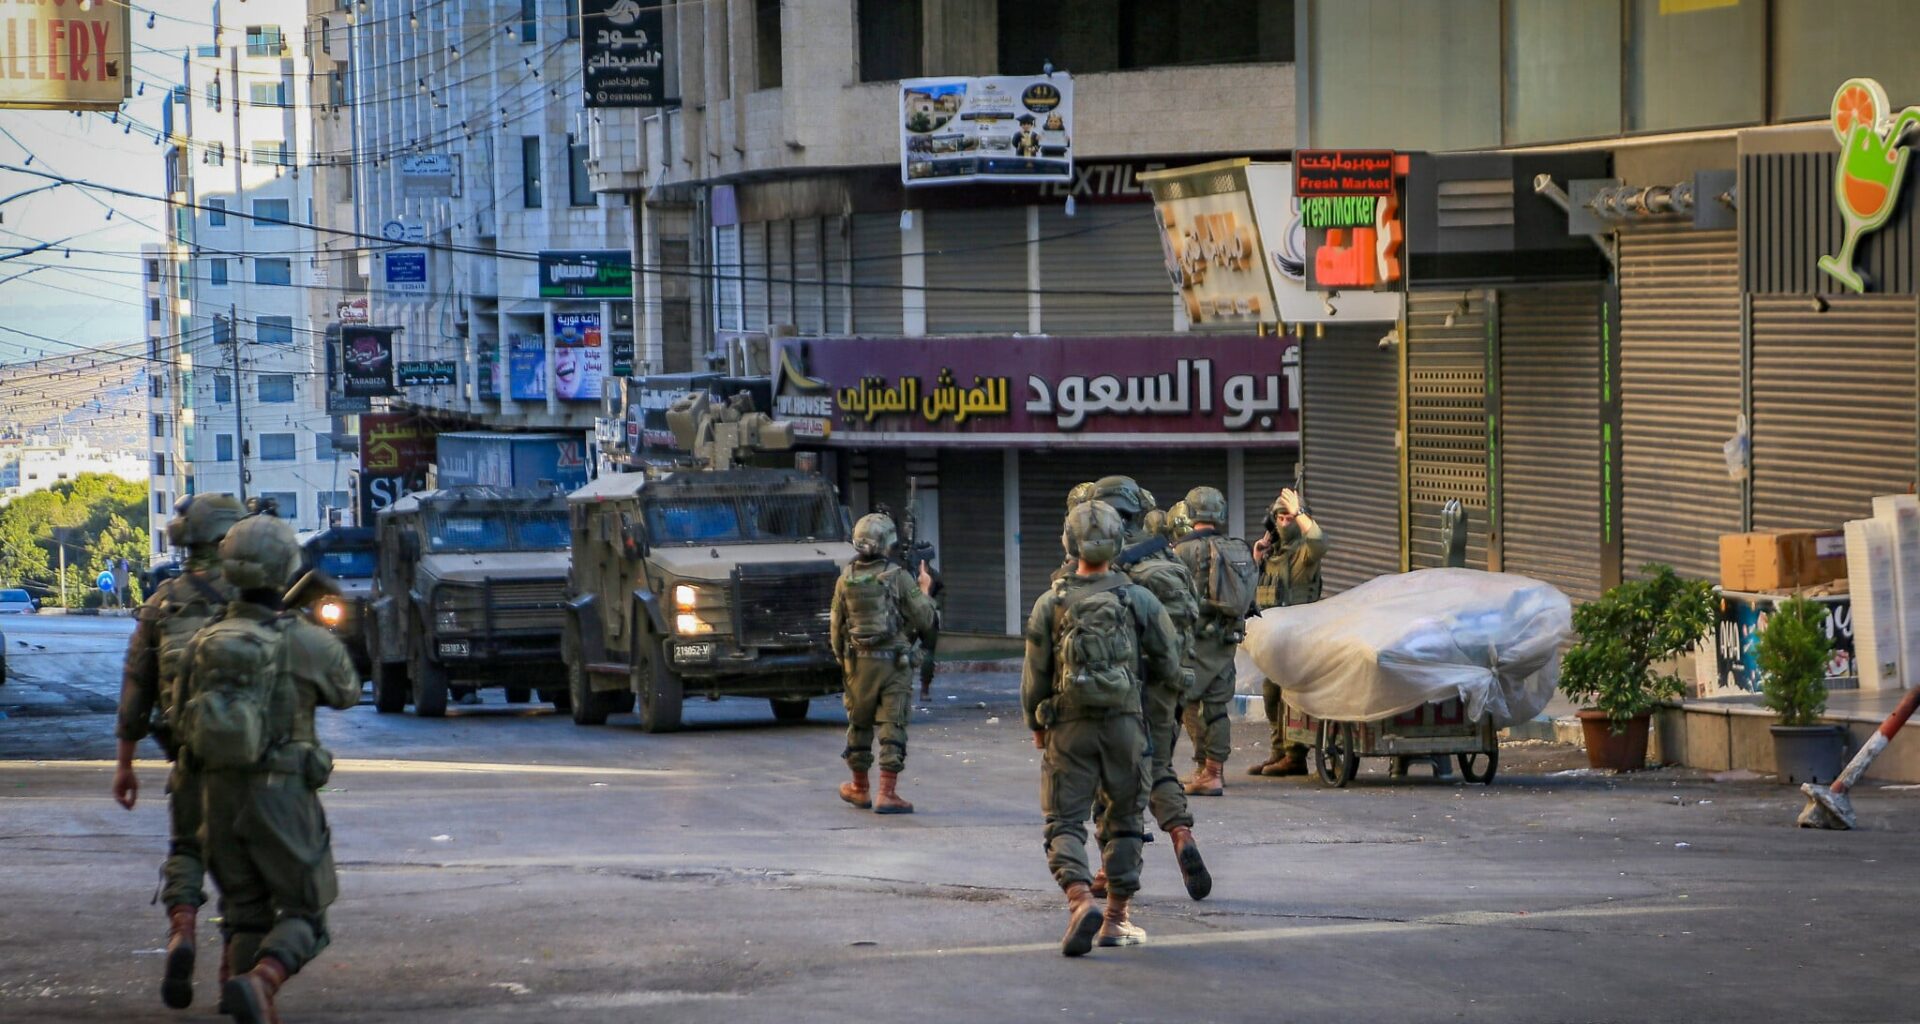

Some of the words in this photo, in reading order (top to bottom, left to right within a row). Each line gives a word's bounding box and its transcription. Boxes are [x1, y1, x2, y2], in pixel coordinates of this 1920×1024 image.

[0, 18, 110, 82] LLERY
[597, 29, 648, 49] جود
[588, 50, 661, 72] للسيدات
[1300, 151, 1390, 170] سوبرماركت
[1300, 177, 1338, 190] Fresh
[1342, 177, 1389, 189] Market
[1301, 196, 1331, 227] Fresh
[1333, 196, 1376, 225] Market
[836, 376, 916, 423] المنزلي
[922, 366, 1009, 423] للفرش
[1025, 358, 1213, 430] السعود
[1222, 345, 1299, 430] أبو
[556, 441, 585, 468] XL
